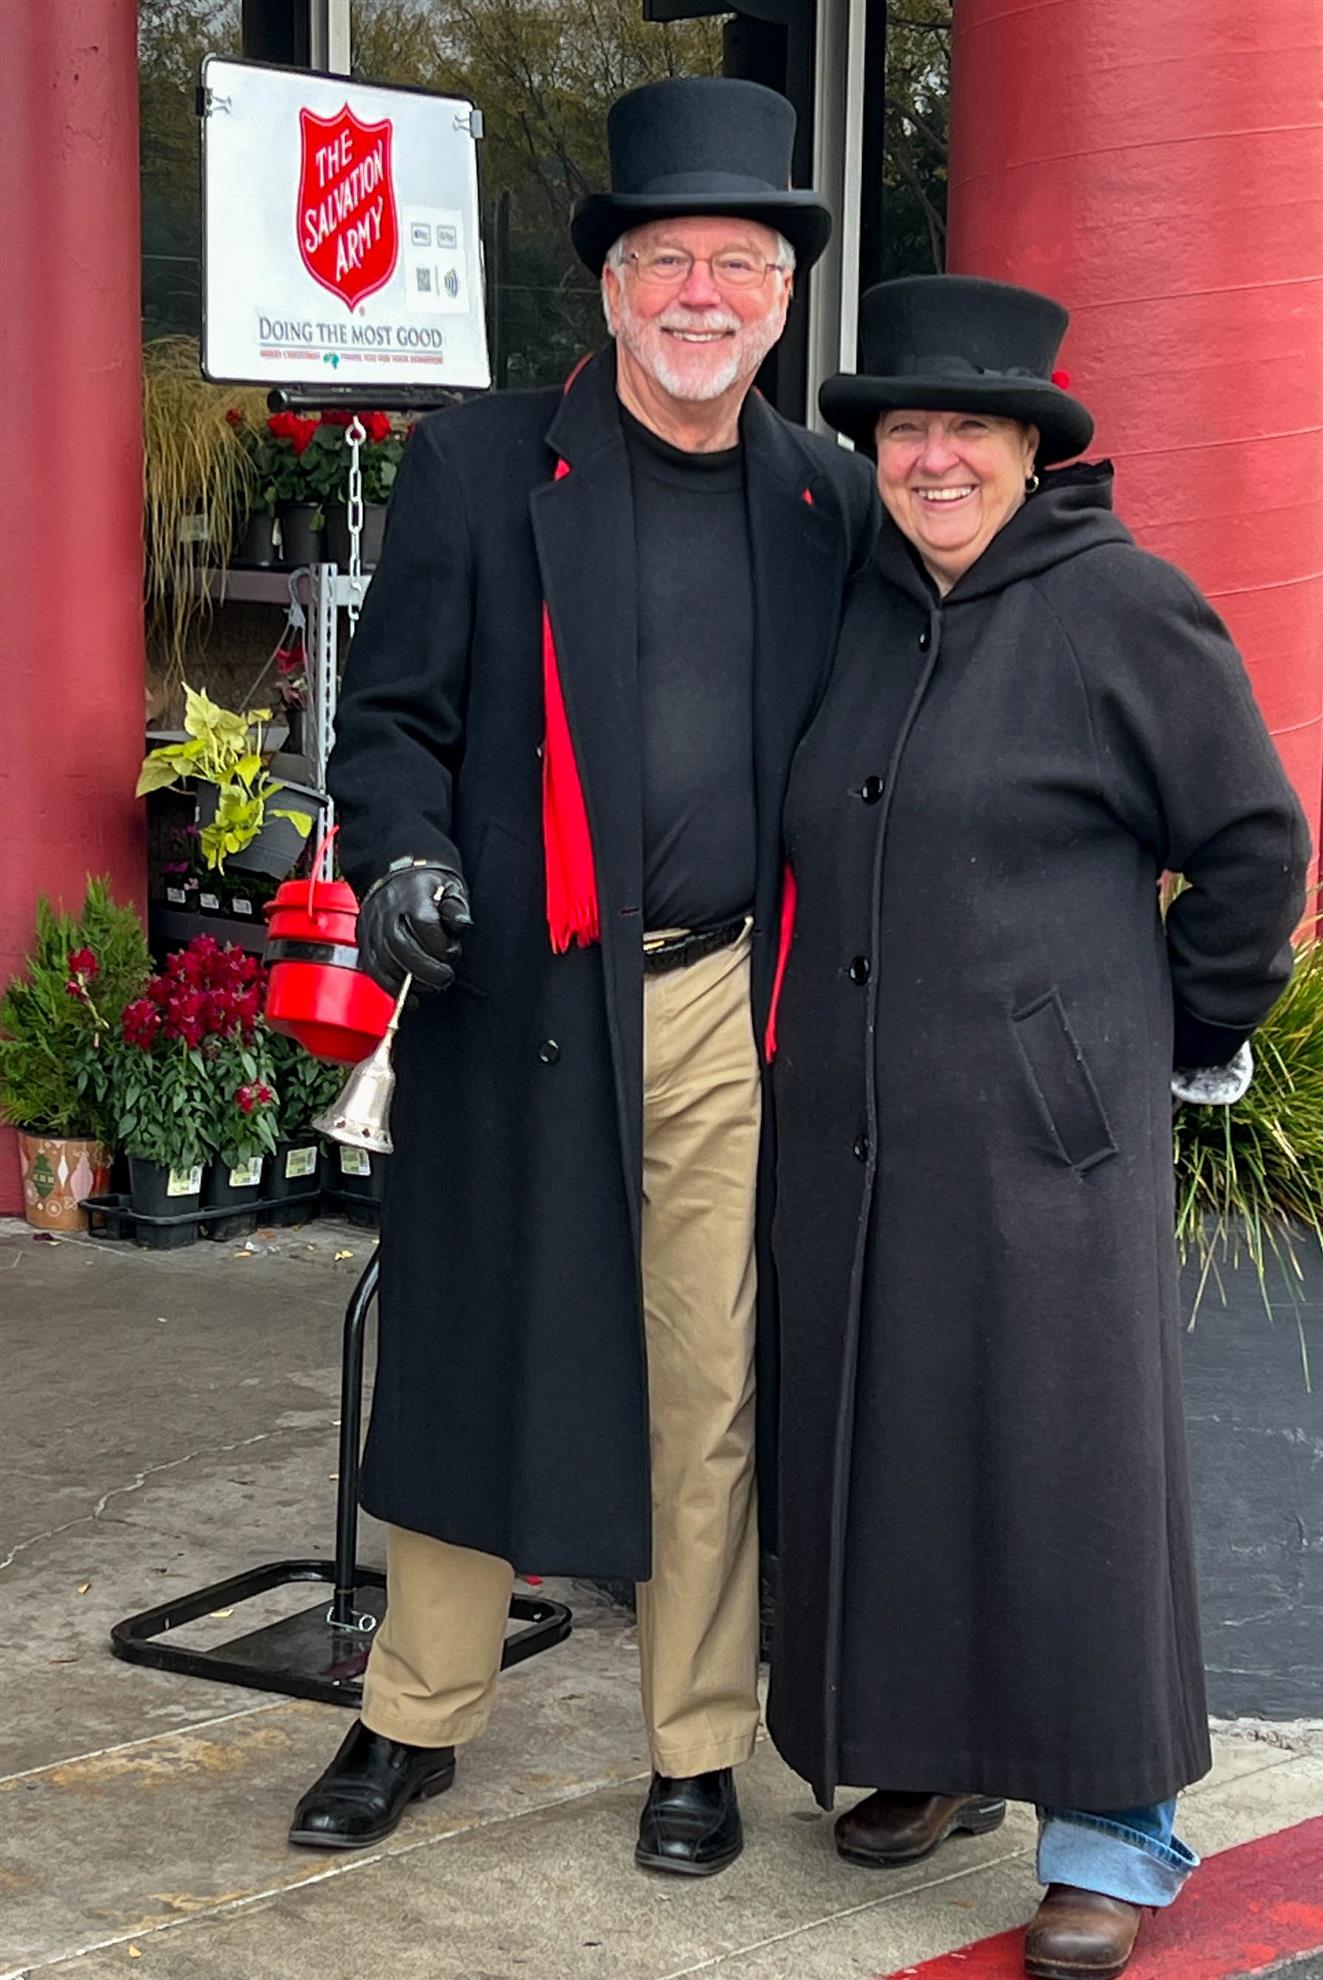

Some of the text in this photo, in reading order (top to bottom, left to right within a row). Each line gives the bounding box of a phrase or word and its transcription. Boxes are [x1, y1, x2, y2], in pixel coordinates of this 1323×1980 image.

[316, 129, 353, 188] THE
[305, 139, 384, 253] SALVATION
[335, 195, 383, 283] ARMY
[259, 317, 443, 348] DOING THE MOST GOOD
